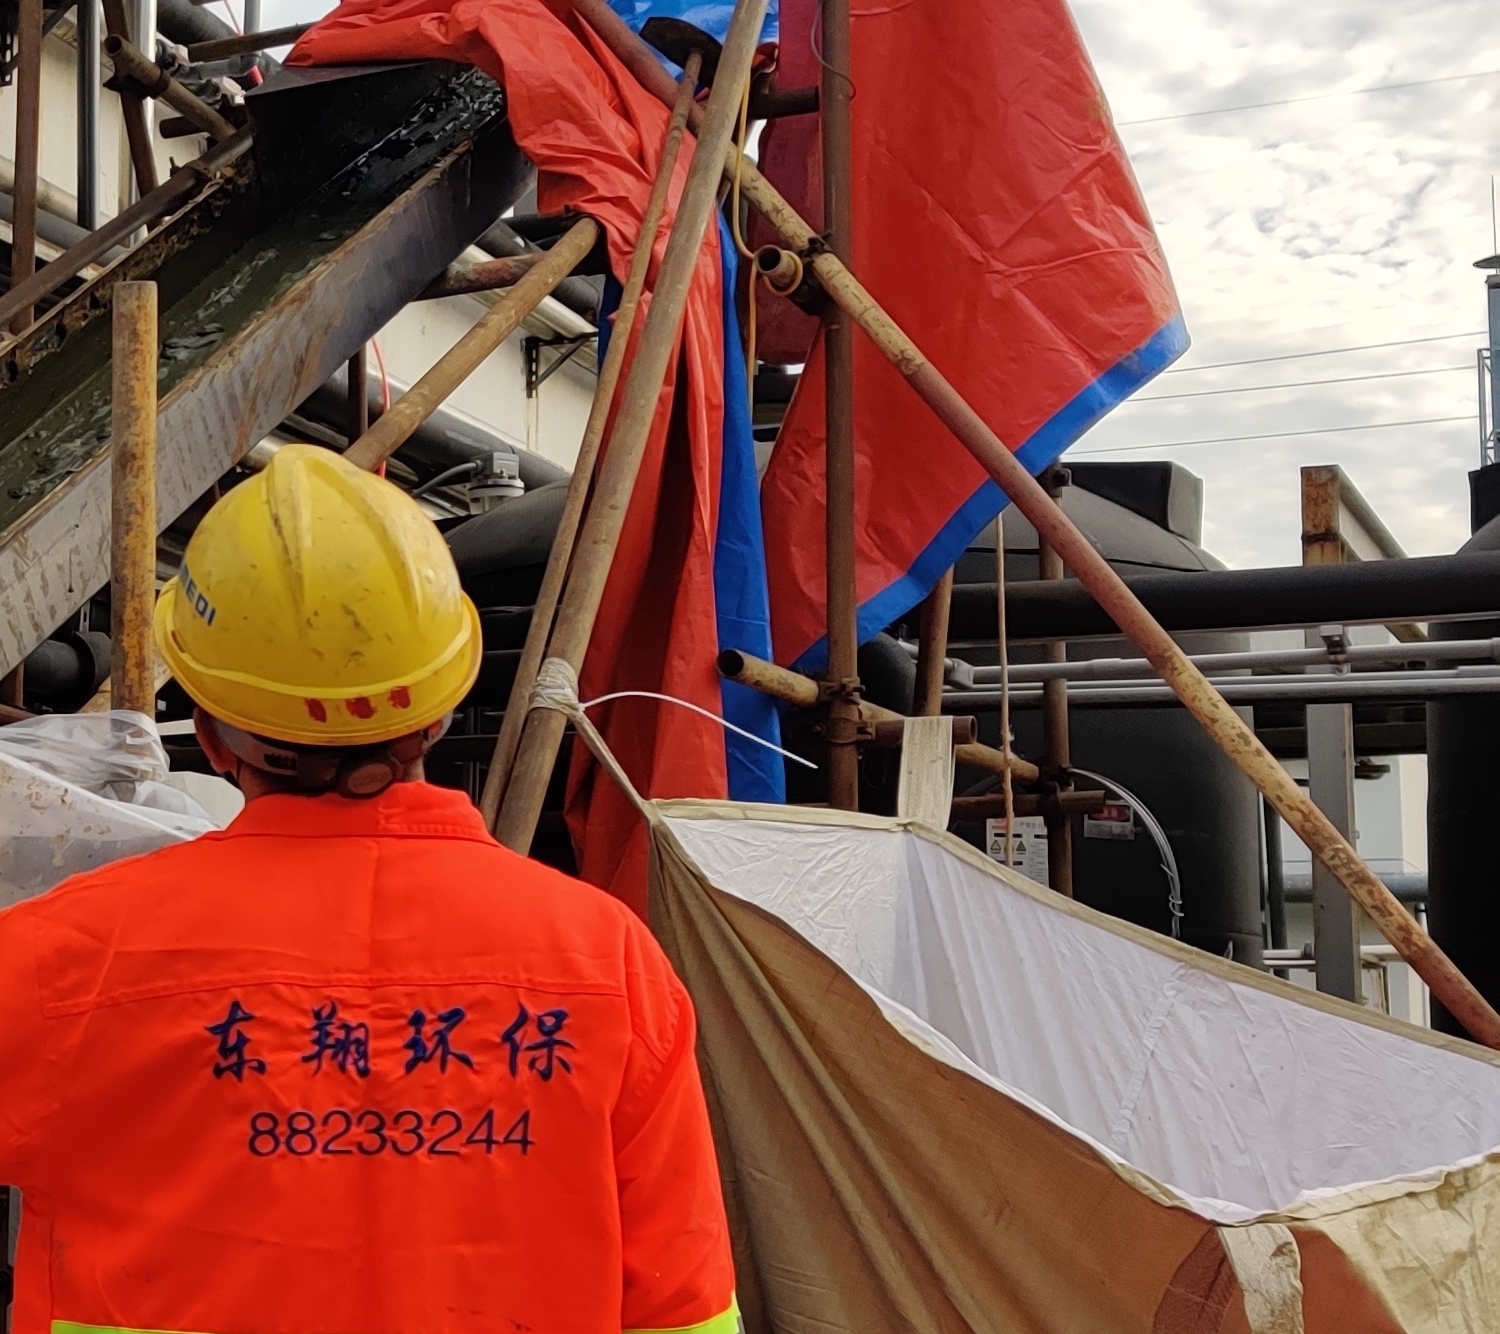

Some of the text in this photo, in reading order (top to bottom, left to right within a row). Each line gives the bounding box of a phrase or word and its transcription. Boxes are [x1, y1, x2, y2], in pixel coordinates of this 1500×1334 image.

[205, 1000, 575, 1082] 东翔环保
[248, 1108, 535, 1157] 88233244
